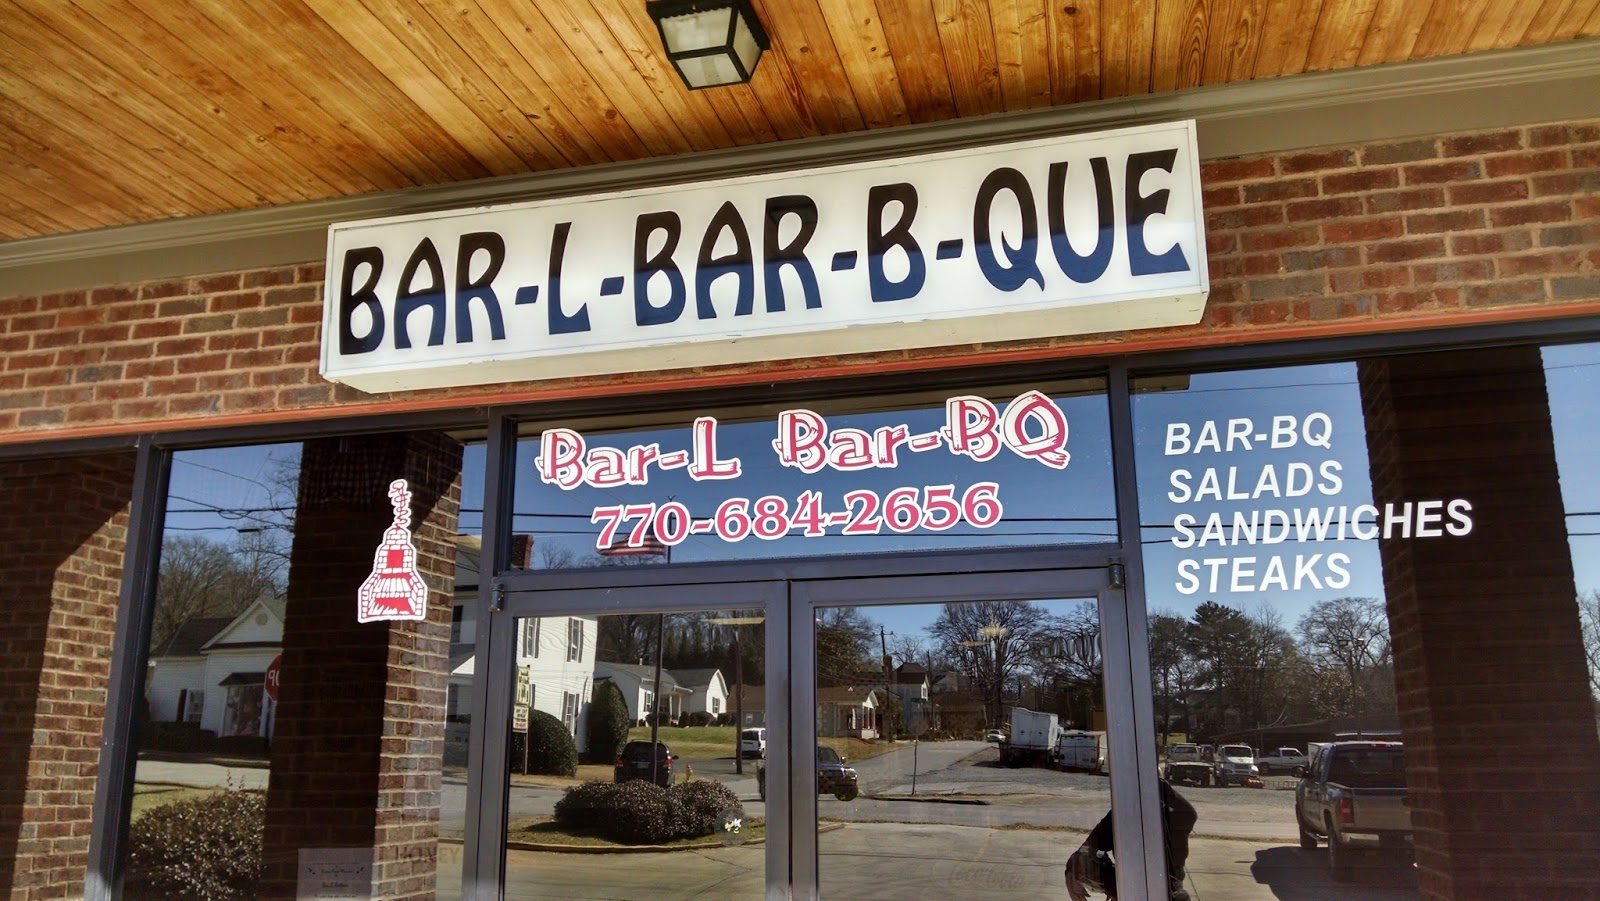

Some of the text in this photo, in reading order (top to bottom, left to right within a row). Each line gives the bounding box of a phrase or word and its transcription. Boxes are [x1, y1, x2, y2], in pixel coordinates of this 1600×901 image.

[339, 148, 1191, 355] BAR-L-BAR-B-QUE
[535, 390, 1071, 491] Bar-L Bar-BQ
[1164, 411, 1333, 456] BAR-BQ
[1167, 459, 1344, 504] SALADS
[590, 481, 1003, 550] 770-684-2656
[1171, 498, 1473, 549] SANDWICHES
[1174, 552, 1351, 595] STEAKS
